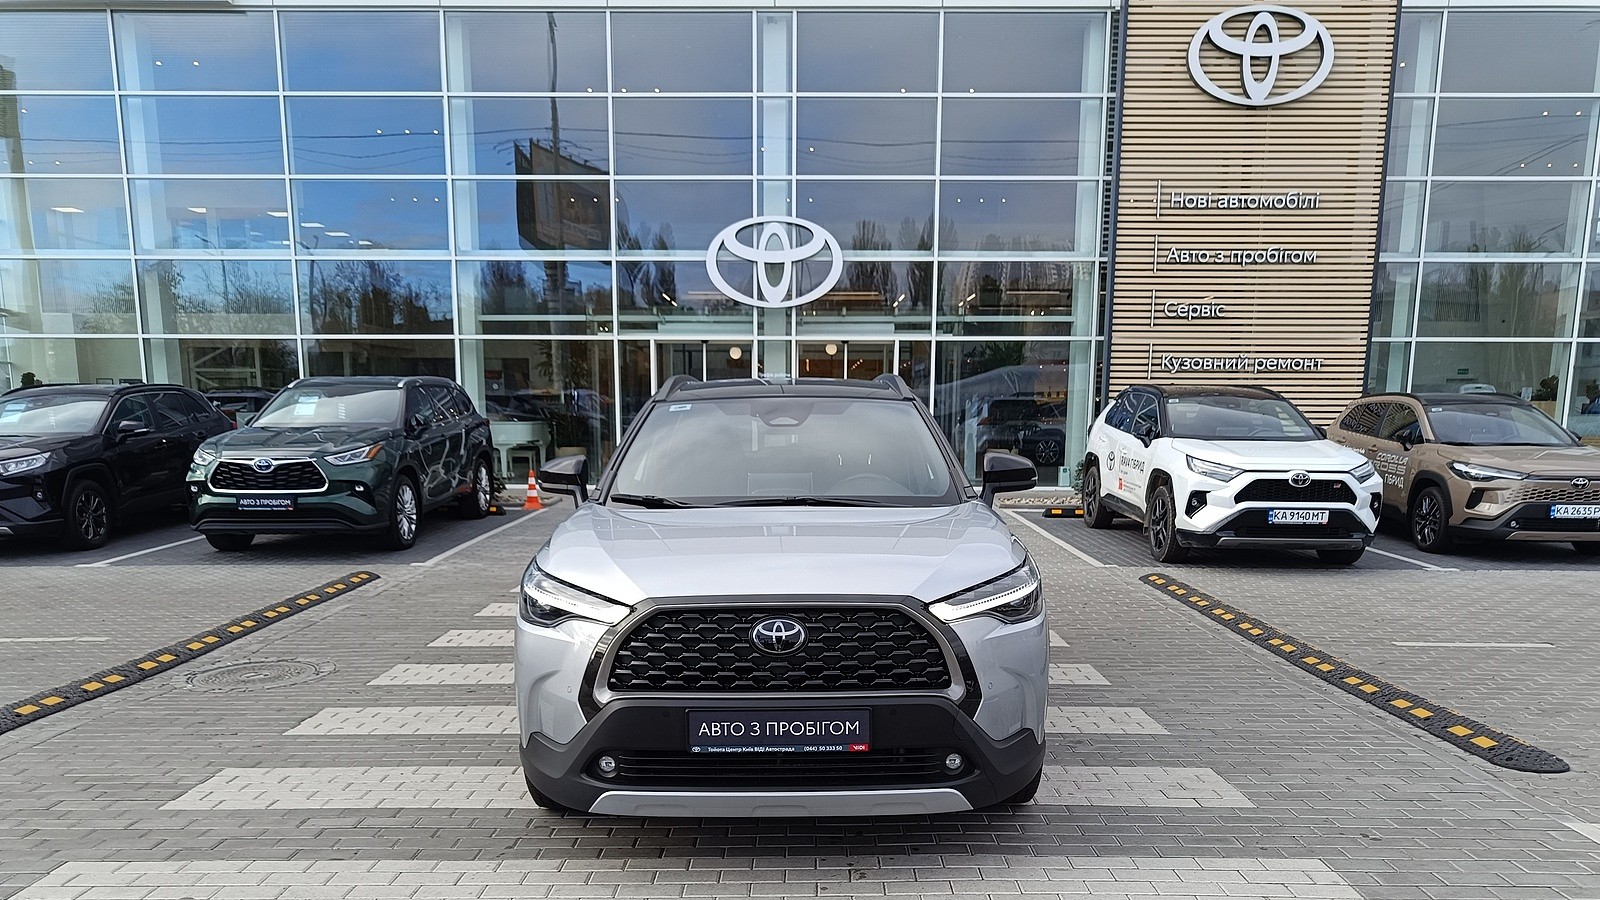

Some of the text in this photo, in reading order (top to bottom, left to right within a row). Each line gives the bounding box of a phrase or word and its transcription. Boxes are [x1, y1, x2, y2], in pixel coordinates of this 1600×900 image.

[1170, 191, 1320, 209] Нові автомобілі
[1166, 246, 1318, 267] Авто з пробігом
[1164, 301, 1227, 321] Сервіс
[1161, 353, 1325, 374] Кузовний ремонт
[1371, 459, 1407, 475] ROSS
[1376, 452, 1409, 466] COROLLA
[1289, 511, 1310, 521] 9140
[698, 720, 860, 736] АВТО З ПРОБІГОМ
